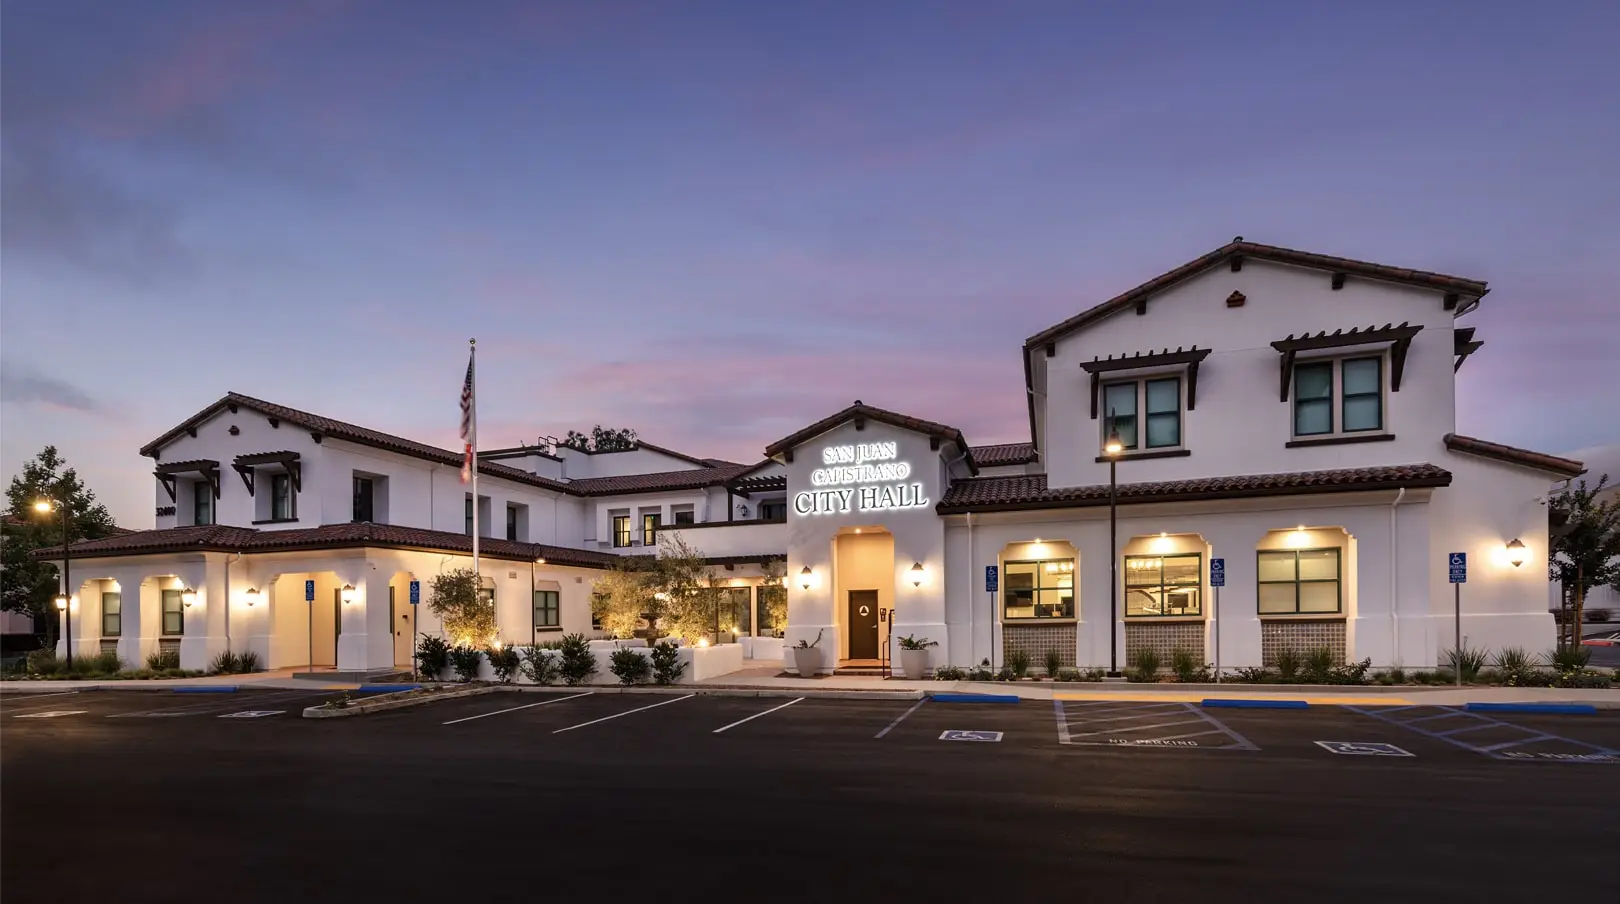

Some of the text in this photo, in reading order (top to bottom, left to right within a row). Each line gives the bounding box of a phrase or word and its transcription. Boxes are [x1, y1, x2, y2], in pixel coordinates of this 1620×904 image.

[823, 441, 897, 464] SAN JUAN
[812, 462, 910, 485] CAPISTRANO
[794, 483, 929, 515] CITY HALL
